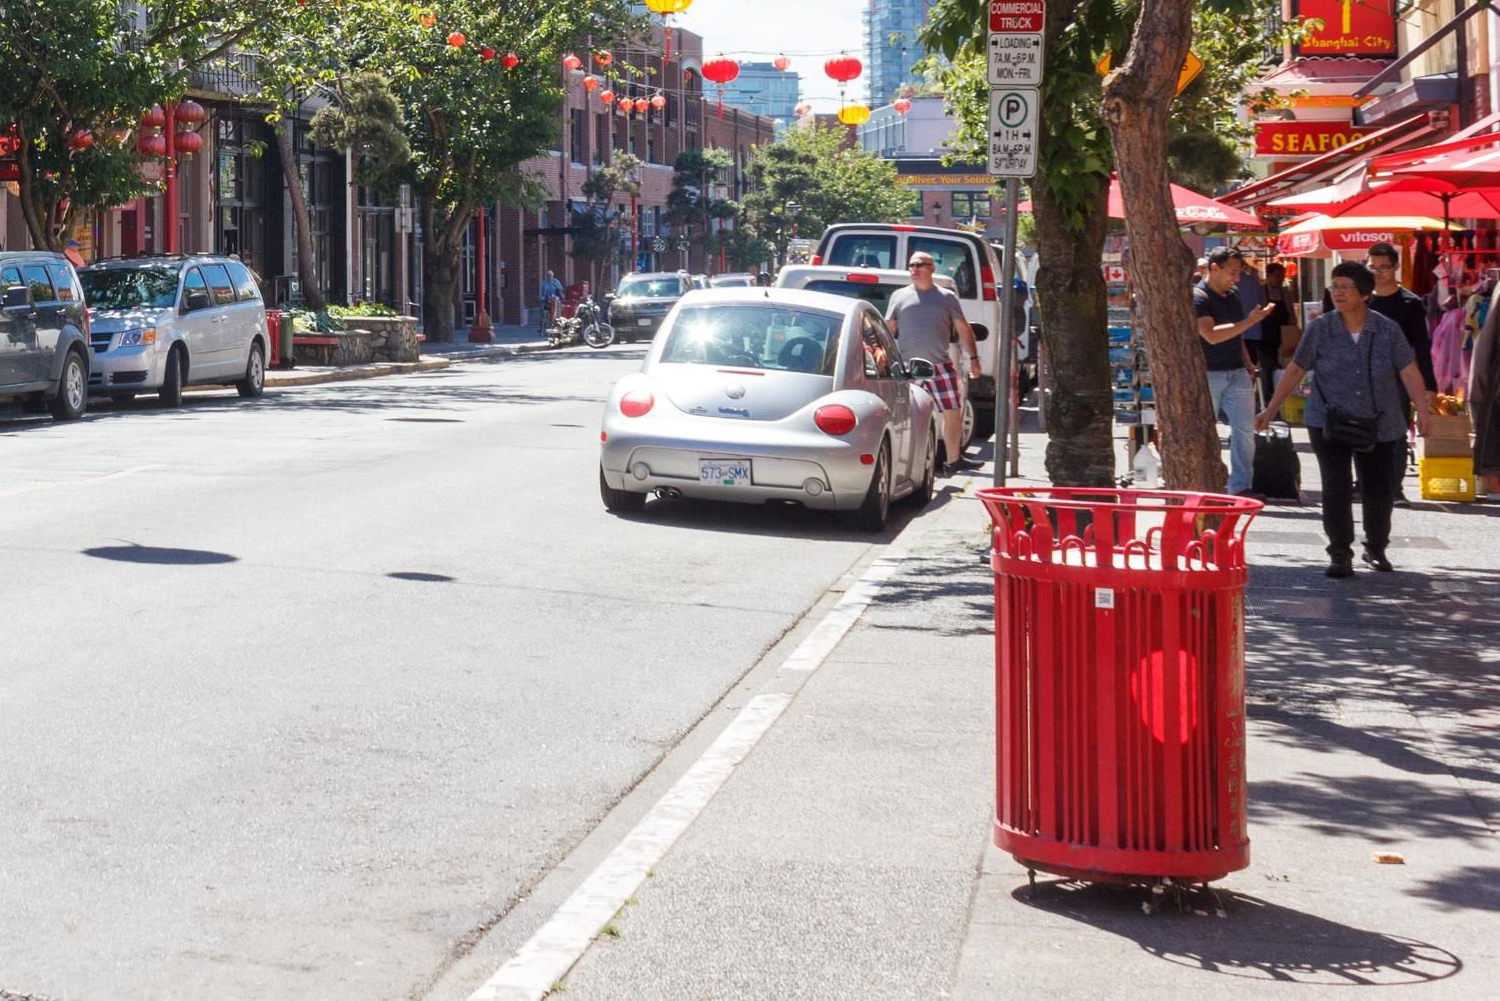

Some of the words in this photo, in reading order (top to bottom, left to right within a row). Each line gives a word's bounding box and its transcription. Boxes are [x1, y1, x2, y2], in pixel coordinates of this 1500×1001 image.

[991, 2, 1043, 14] COMMERCIAL
[1000, 17, 1032, 29] TRUCK
[1000, 37, 1032, 49] LOADING
[1302, 35, 1359, 50] Shanghai
[1363, 35, 1391, 49] City
[1272, 132, 1384, 152] SEAFOO
[940, 175, 961, 184] Your
